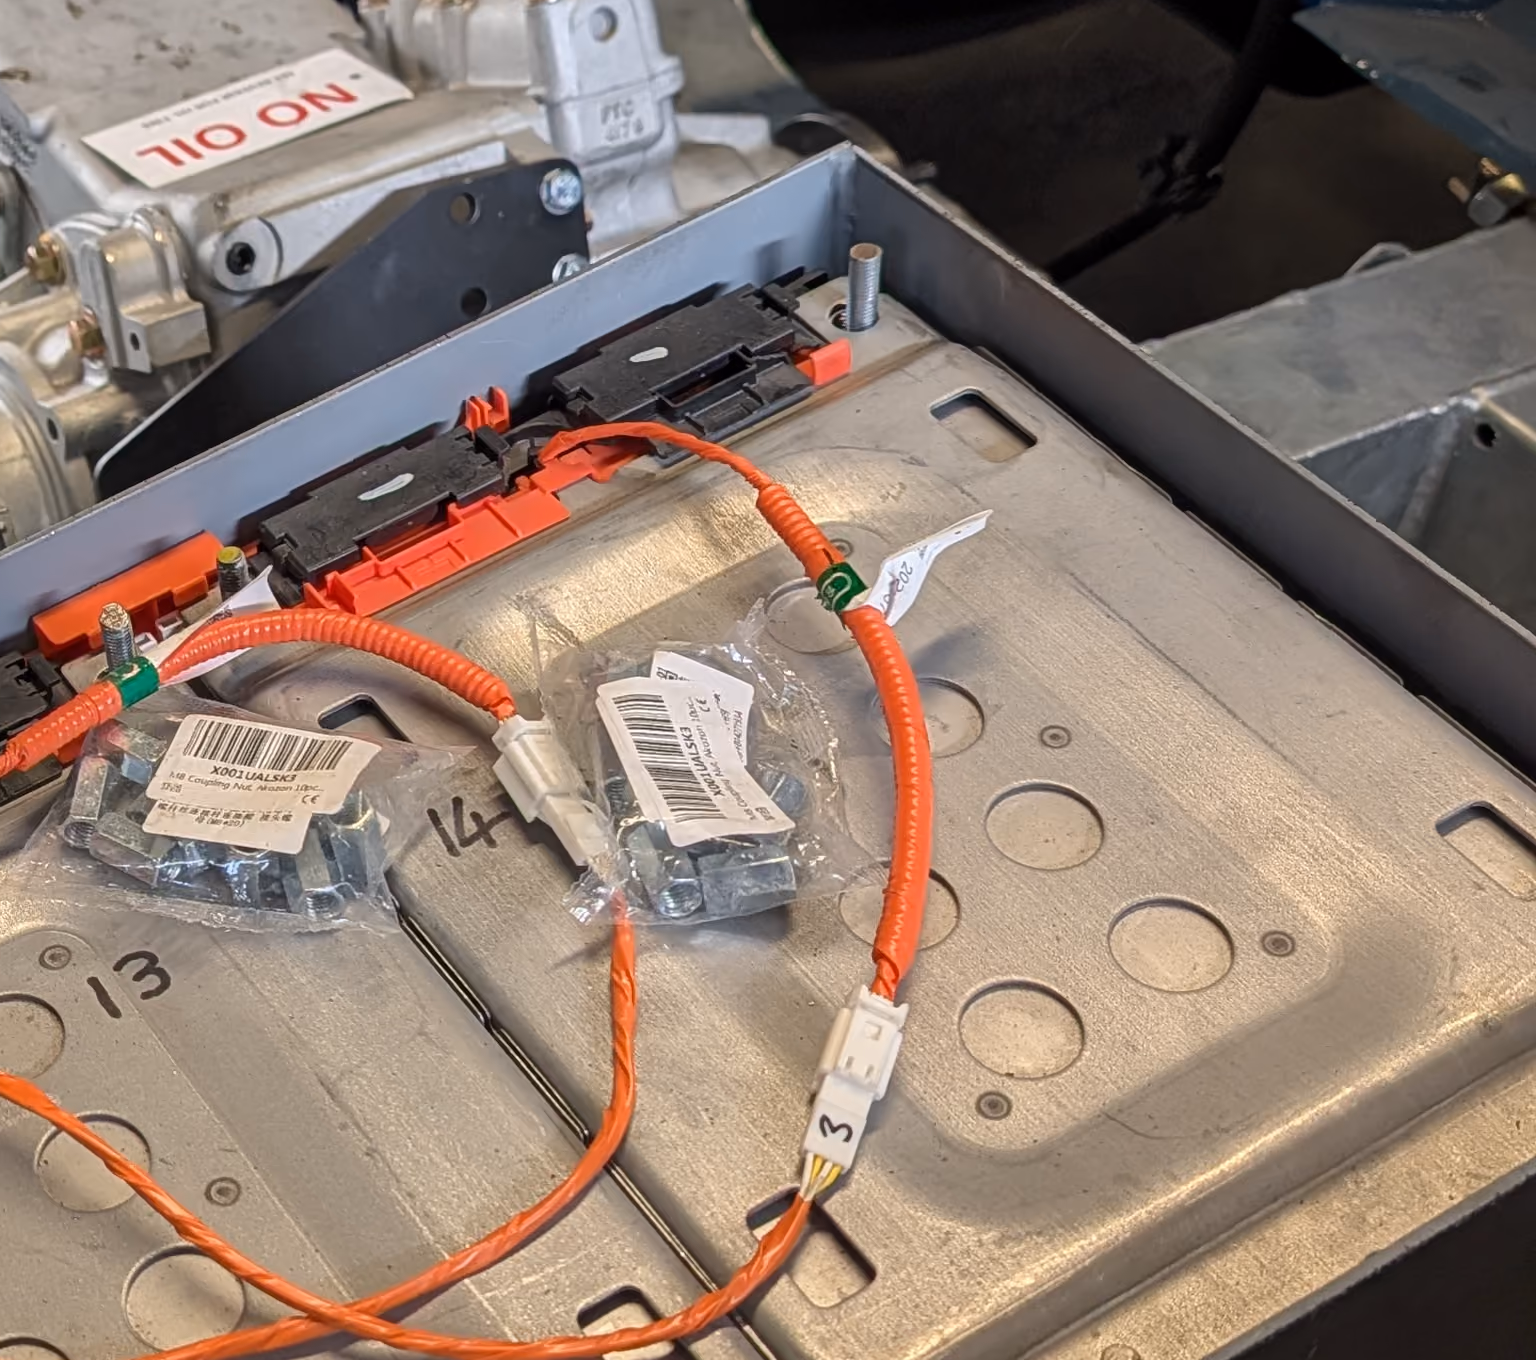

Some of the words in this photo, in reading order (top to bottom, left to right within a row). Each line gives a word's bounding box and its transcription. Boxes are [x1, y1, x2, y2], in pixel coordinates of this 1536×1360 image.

[256, 82, 359, 128] NO
[135, 124, 248, 167] OIL
[187, 775, 231, 791] Coupling
[233, 783, 253, 792] Nut
[210, 765, 297, 782] X001UALSK3
[679, 726, 726, 798] X001UALSK3
[426, 796, 513, 857] 14
[86, 950, 171, 1019] 13
[819, 1114, 853, 1143] 3
